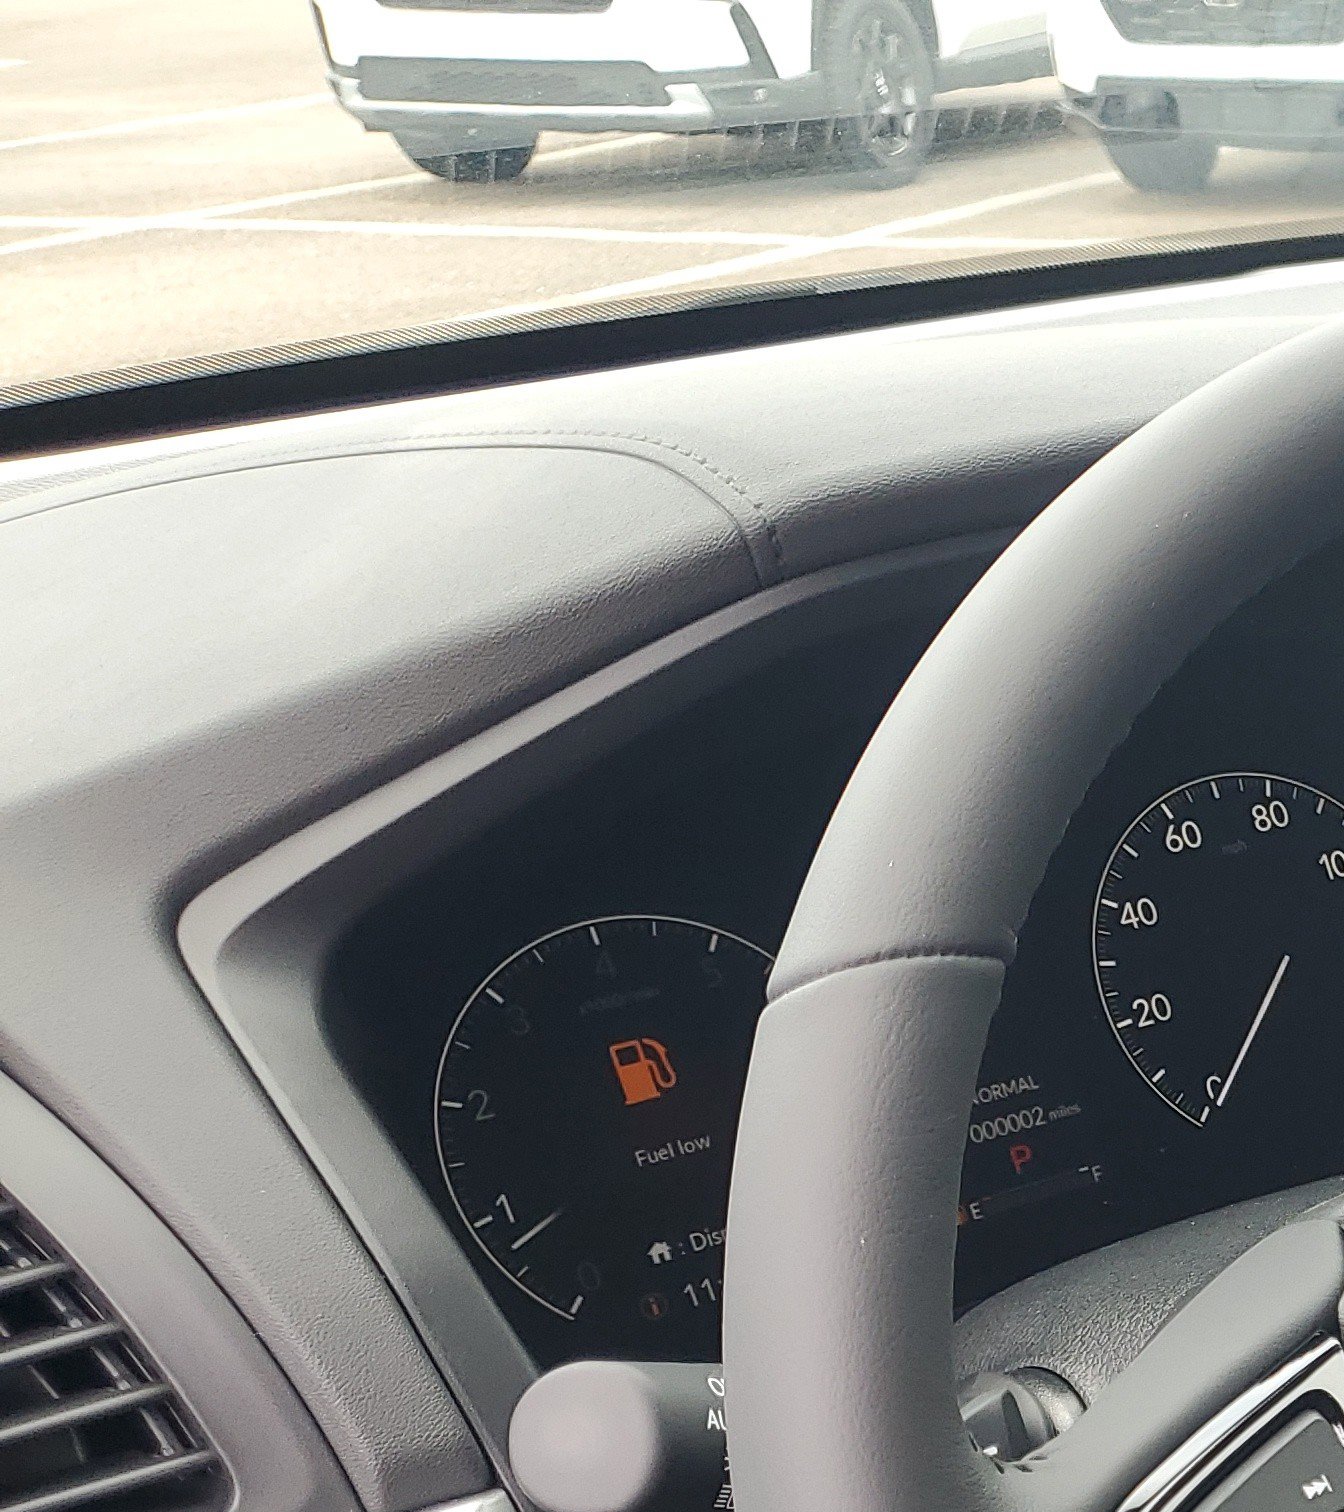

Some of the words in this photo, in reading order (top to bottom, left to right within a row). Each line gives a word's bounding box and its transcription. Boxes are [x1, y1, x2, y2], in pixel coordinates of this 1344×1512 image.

[1252, 799, 1290, 833] 80
[1165, 821, 1203, 854] 60
[1120, 896, 1158, 931] 40
[1132, 993, 1173, 1028] 20
[467, 1089, 496, 1122] 2
[972, 1075, 1040, 1105] ORMAL
[969, 1105, 1047, 1144] 000002
[634, 1140, 675, 1168] Fuel
[678, 1133, 712, 1159] low
[1009, 1144, 1033, 1175] P
[495, 1193, 516, 1224] 1
[969, 1201, 984, 1221] E
